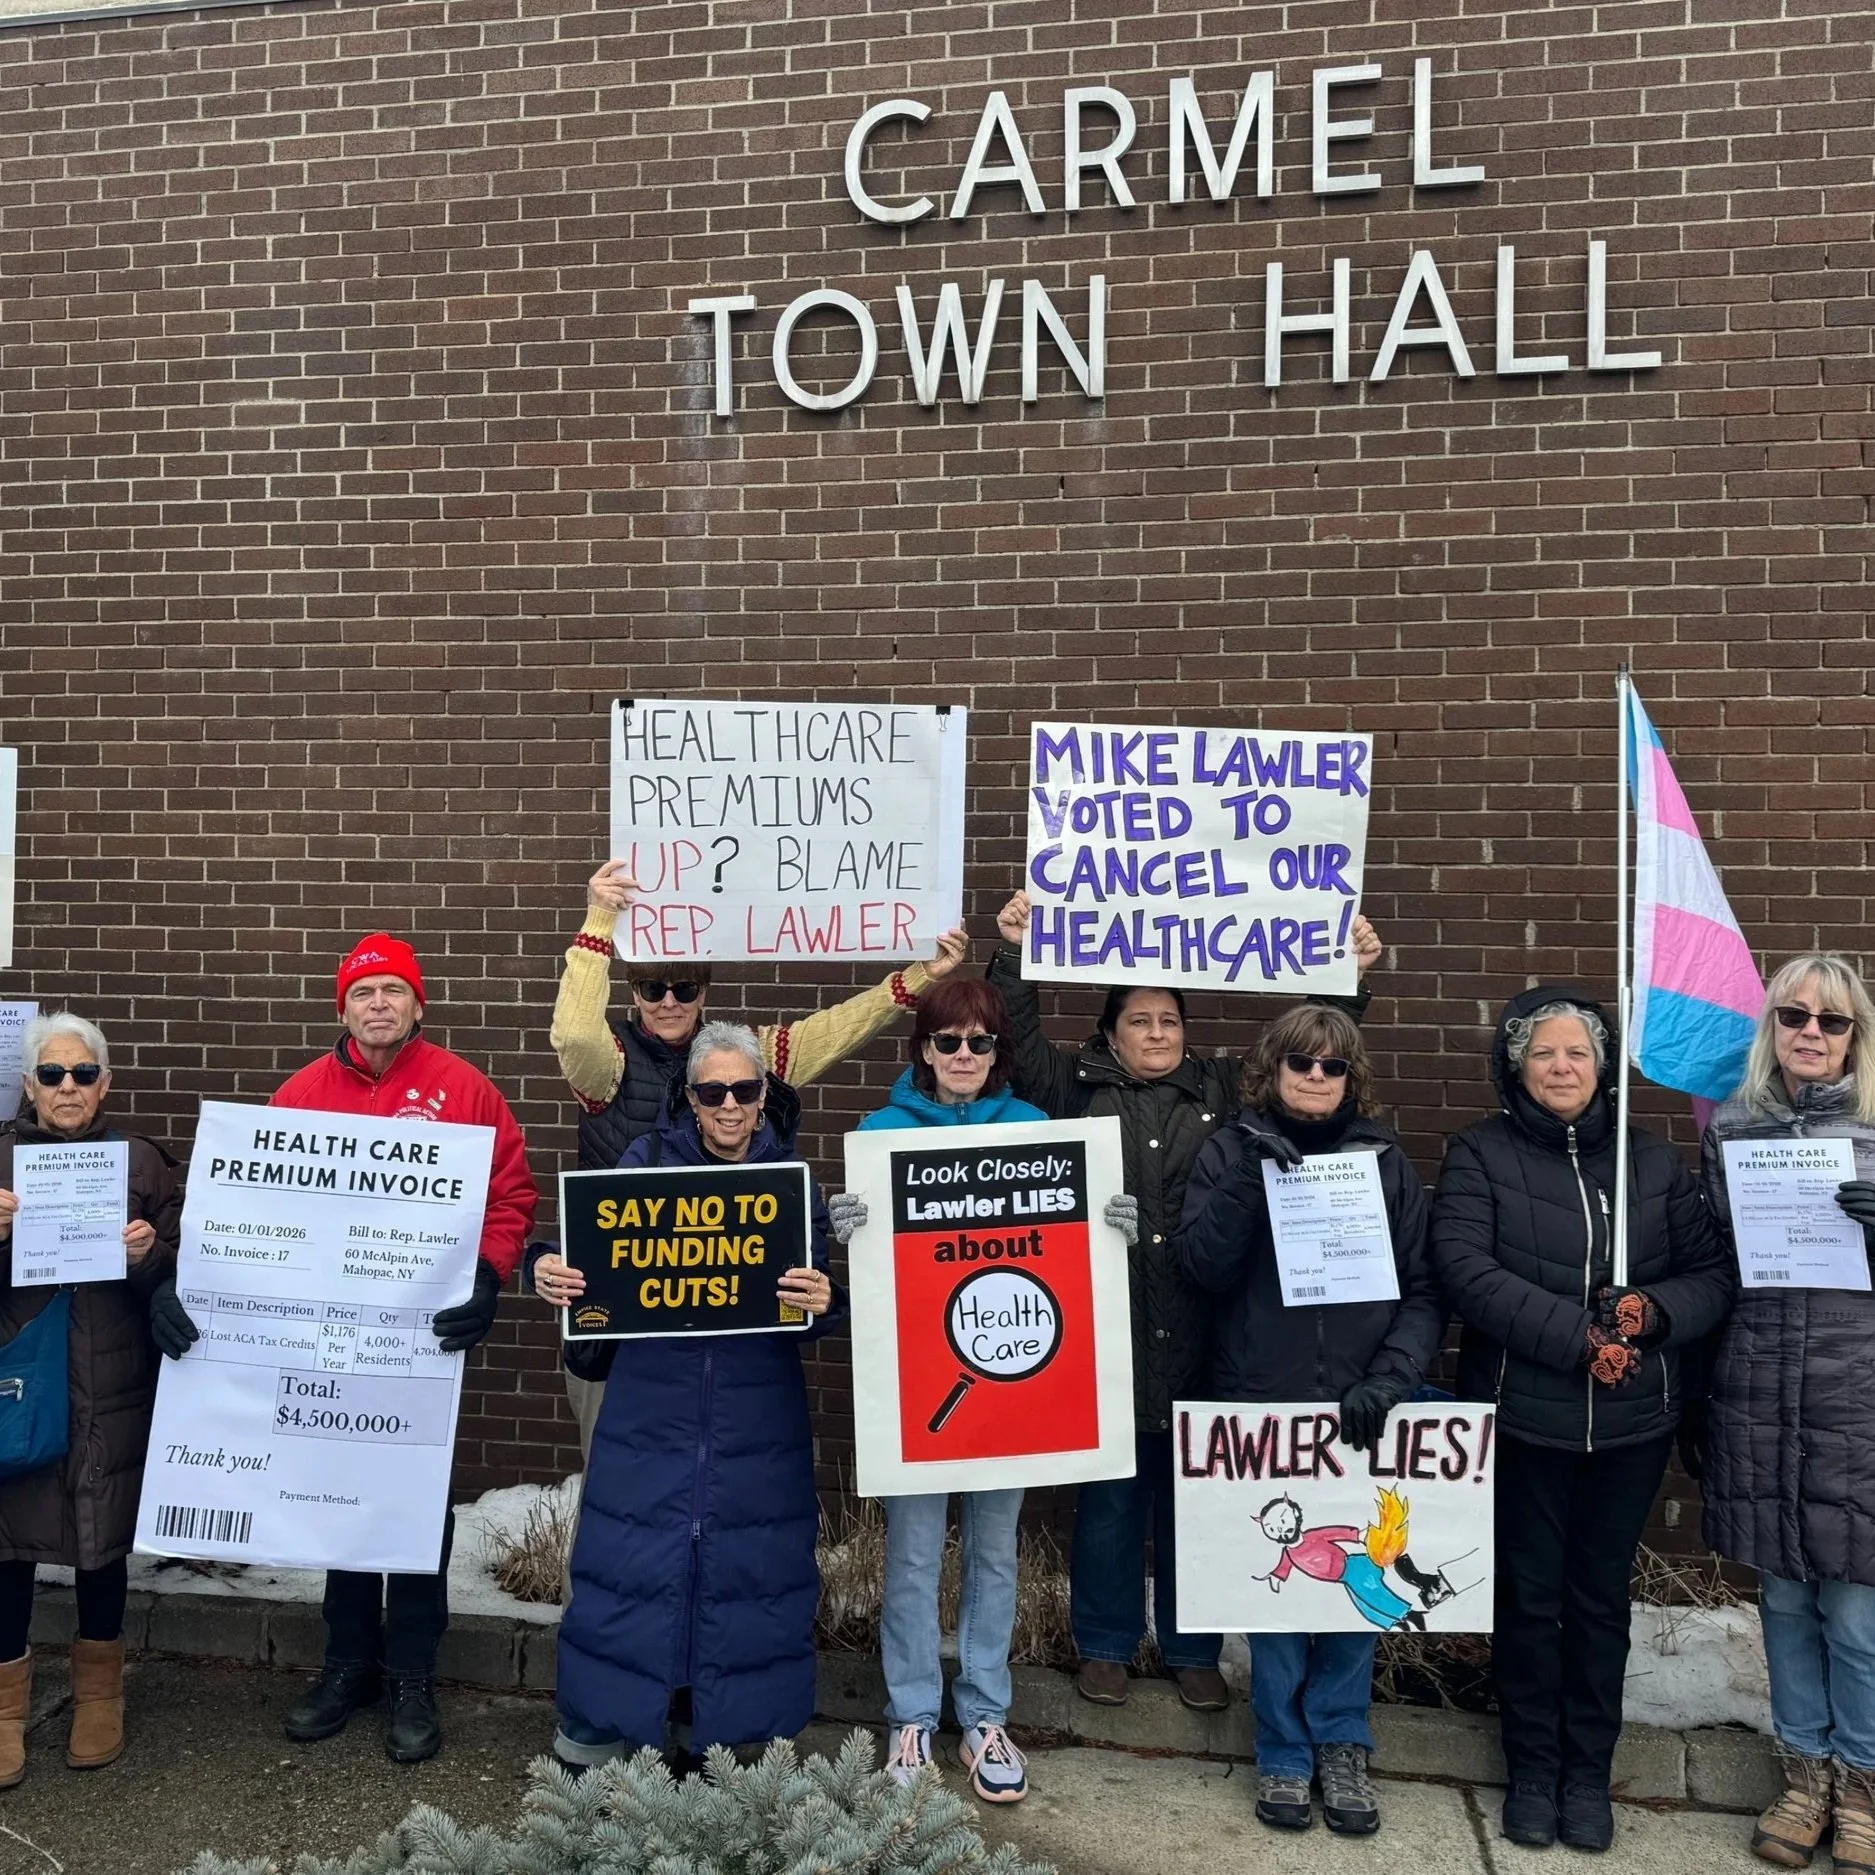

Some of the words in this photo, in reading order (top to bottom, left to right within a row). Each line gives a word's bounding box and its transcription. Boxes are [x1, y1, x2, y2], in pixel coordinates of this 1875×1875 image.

[844, 58, 1485, 226] CARMEL
[688, 274, 1106, 419] TOWN
[1264, 240, 1663, 389] HALL
[623, 710, 919, 764] HEALTHCARE
[1036, 726, 1179, 786] MIKE
[1193, 731, 1369, 798] LAWLER
[630, 774, 873, 828] PREMIUMS
[1032, 787, 1193, 841] VOTED
[1221, 789, 1292, 840] TO
[630, 836, 740, 894] UP?
[777, 835, 924, 892] BLAME
[1030, 842, 1249, 902] CANCEL
[1269, 843, 1358, 896] OUR
[631, 902, 714, 956] REP.
[747, 902, 917, 954] LAWLER
[1031, 899, 1355, 982] HEALTHCARE!
[39, 1152, 76, 1161] HEALTH
[80, 1151, 105, 1159] CARE
[253, 1129, 357, 1158] HEALTH
[369, 1140, 440, 1165] CARE
[1751, 1150, 1793, 1158] HEALTH
[1797, 1149, 1827, 1157] CARE
[25, 1162, 70, 1172] PREMIUM
[74, 1161, 115, 1169] INVOICE
[906, 1160, 970, 1185] Look
[976, 1155, 1073, 1182] Closely:
[1287, 1164, 1325, 1174] HEALTH
[1328, 1162, 1354, 1171] CARE
[1738, 1161, 1788, 1169] PREMIUM
[1792, 1160, 1840, 1168] INVOICE
[210, 1158, 337, 1189] PREMIUM
[348, 1170, 464, 1200] INVOICE
[1276, 1175, 1321, 1185] PREMIUM
[1324, 1172, 1366, 1181] INVOICE
[597, 1198, 666, 1229] SAY
[675, 1195, 725, 1227] NO
[734, 1193, 778, 1224] TO
[907, 1194, 1006, 1220] Lawler
[1013, 1187, 1076, 1215] LIES
[204, 1220, 236, 1234] Date:
[238, 1222, 307, 1239] 01/01/2026
[348, 1225, 369, 1238] Bill
[372, 1227, 387, 1240] to:
[389, 1230, 416, 1244] Rep.
[418, 1232, 460, 1246] Lawler
[45, 1249, 60, 1257] you!
[200, 1244, 222, 1257] No.
[224, 1246, 269, 1260] Invoice
[277, 1250, 290, 1262] 17
[611, 1234, 765, 1269] FUNDING
[933, 1229, 1043, 1263] about
[1750, 1252, 1774, 1260] Thank
[1774, 1252, 1791, 1260] you!
[344, 1249, 360, 1260] 60
[362, 1251, 409, 1266] McAlpin
[411, 1254, 434, 1267] Ave,
[342, 1264, 395, 1281] Mahopac,
[397, 1268, 416, 1280] NY
[1289, 1268, 1310, 1276] Thank
[1311, 1266, 1326, 1276] you!
[186, 1294, 209, 1305] Date
[639, 1275, 739, 1309] CUTS!
[217, 1297, 244, 1310] Item
[247, 1301, 315, 1319] Description
[326, 1306, 358, 1321] Price
[378, 1312, 399, 1325] Qty
[957, 1293, 1053, 1330] Health
[210, 1330, 231, 1342] Lost
[233, 1333, 256, 1344] ACA
[258, 1335, 277, 1347] Tax
[279, 1337, 316, 1350] Credits
[322, 1325, 356, 1339] $1,176
[364, 1336, 406, 1349] 4,000+
[328, 1342, 346, 1354] Per
[972, 1334, 1041, 1362] Care
[322, 1358, 347, 1370] Year
[355, 1352, 411, 1367] Residents
[281, 1375, 341, 1400] Total:
[276, 1404, 412, 1434] $4,500,000+
[1179, 1410, 1344, 1481] LAWLER
[1367, 1412, 1495, 1484] LIES!
[165, 1444, 225, 1467] Thank
[227, 1453, 271, 1474] you!
[279, 1490, 320, 1504] Payment
[322, 1494, 361, 1506] Method:
